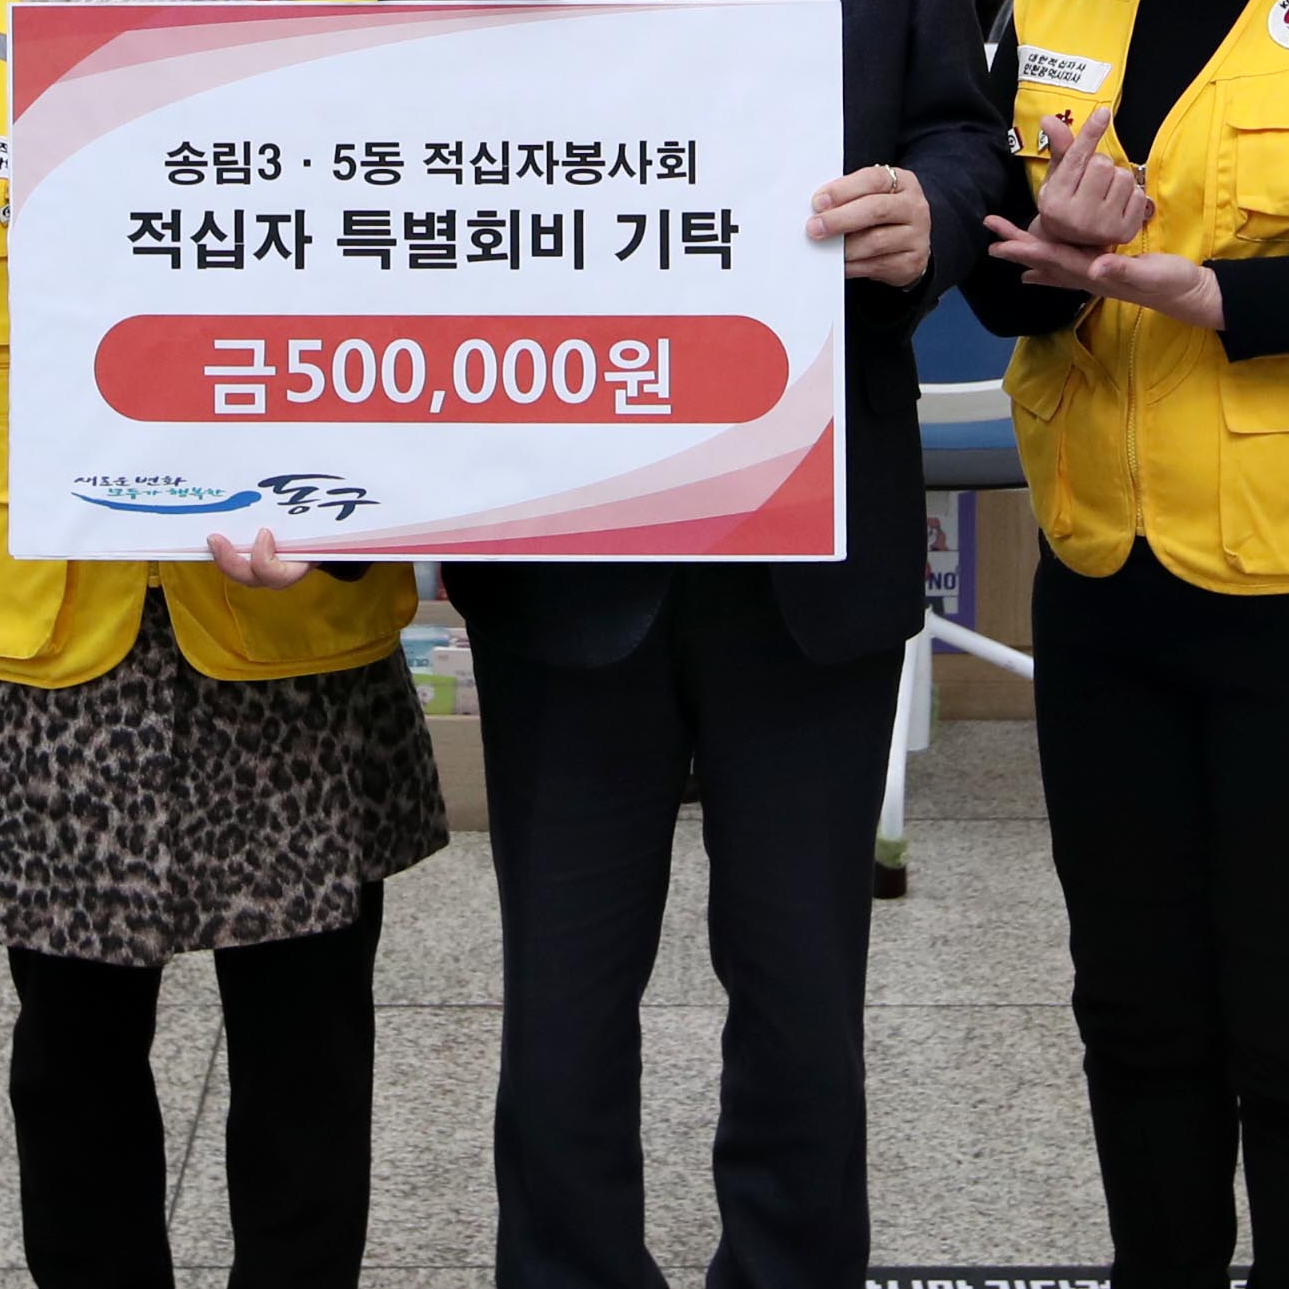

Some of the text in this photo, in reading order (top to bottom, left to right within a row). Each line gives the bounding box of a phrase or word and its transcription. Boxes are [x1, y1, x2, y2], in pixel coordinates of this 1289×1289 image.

[164, 141, 282, 185] 송림3
[332, 141, 405, 186] 5동
[423, 140, 699, 187] 적십자봉사회
[127, 209, 740, 271] 적십자 특별회비 기탁
[204, 337, 673, 416] 금500,000원
[74, 475, 186, 487] 새로운 변화
[107, 486, 226, 501] 모두가 행복한
[258, 474, 381, 521] 동구
